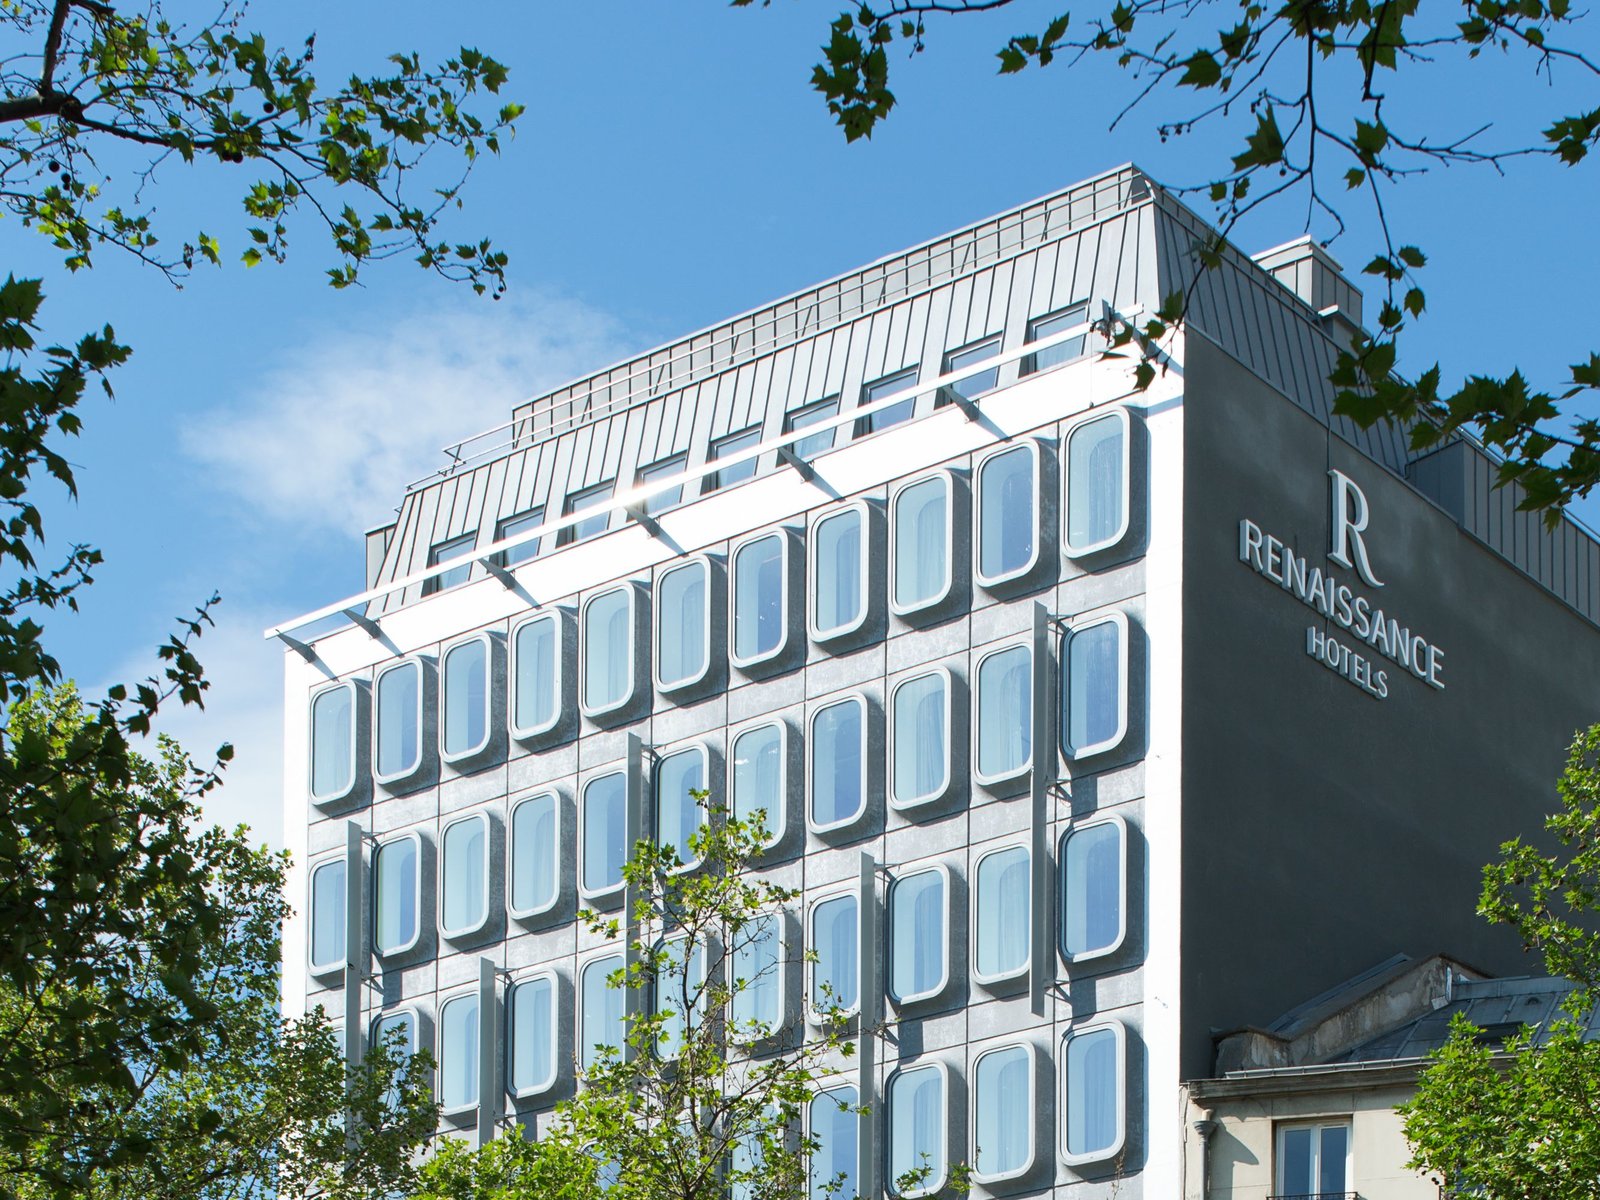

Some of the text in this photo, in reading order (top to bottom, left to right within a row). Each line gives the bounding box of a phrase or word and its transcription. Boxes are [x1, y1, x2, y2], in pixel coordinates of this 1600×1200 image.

[1326, 469, 1385, 588] R
[1239, 518, 1445, 689] RENAISSANCE
[1306, 626, 1388, 699] HOTELS
